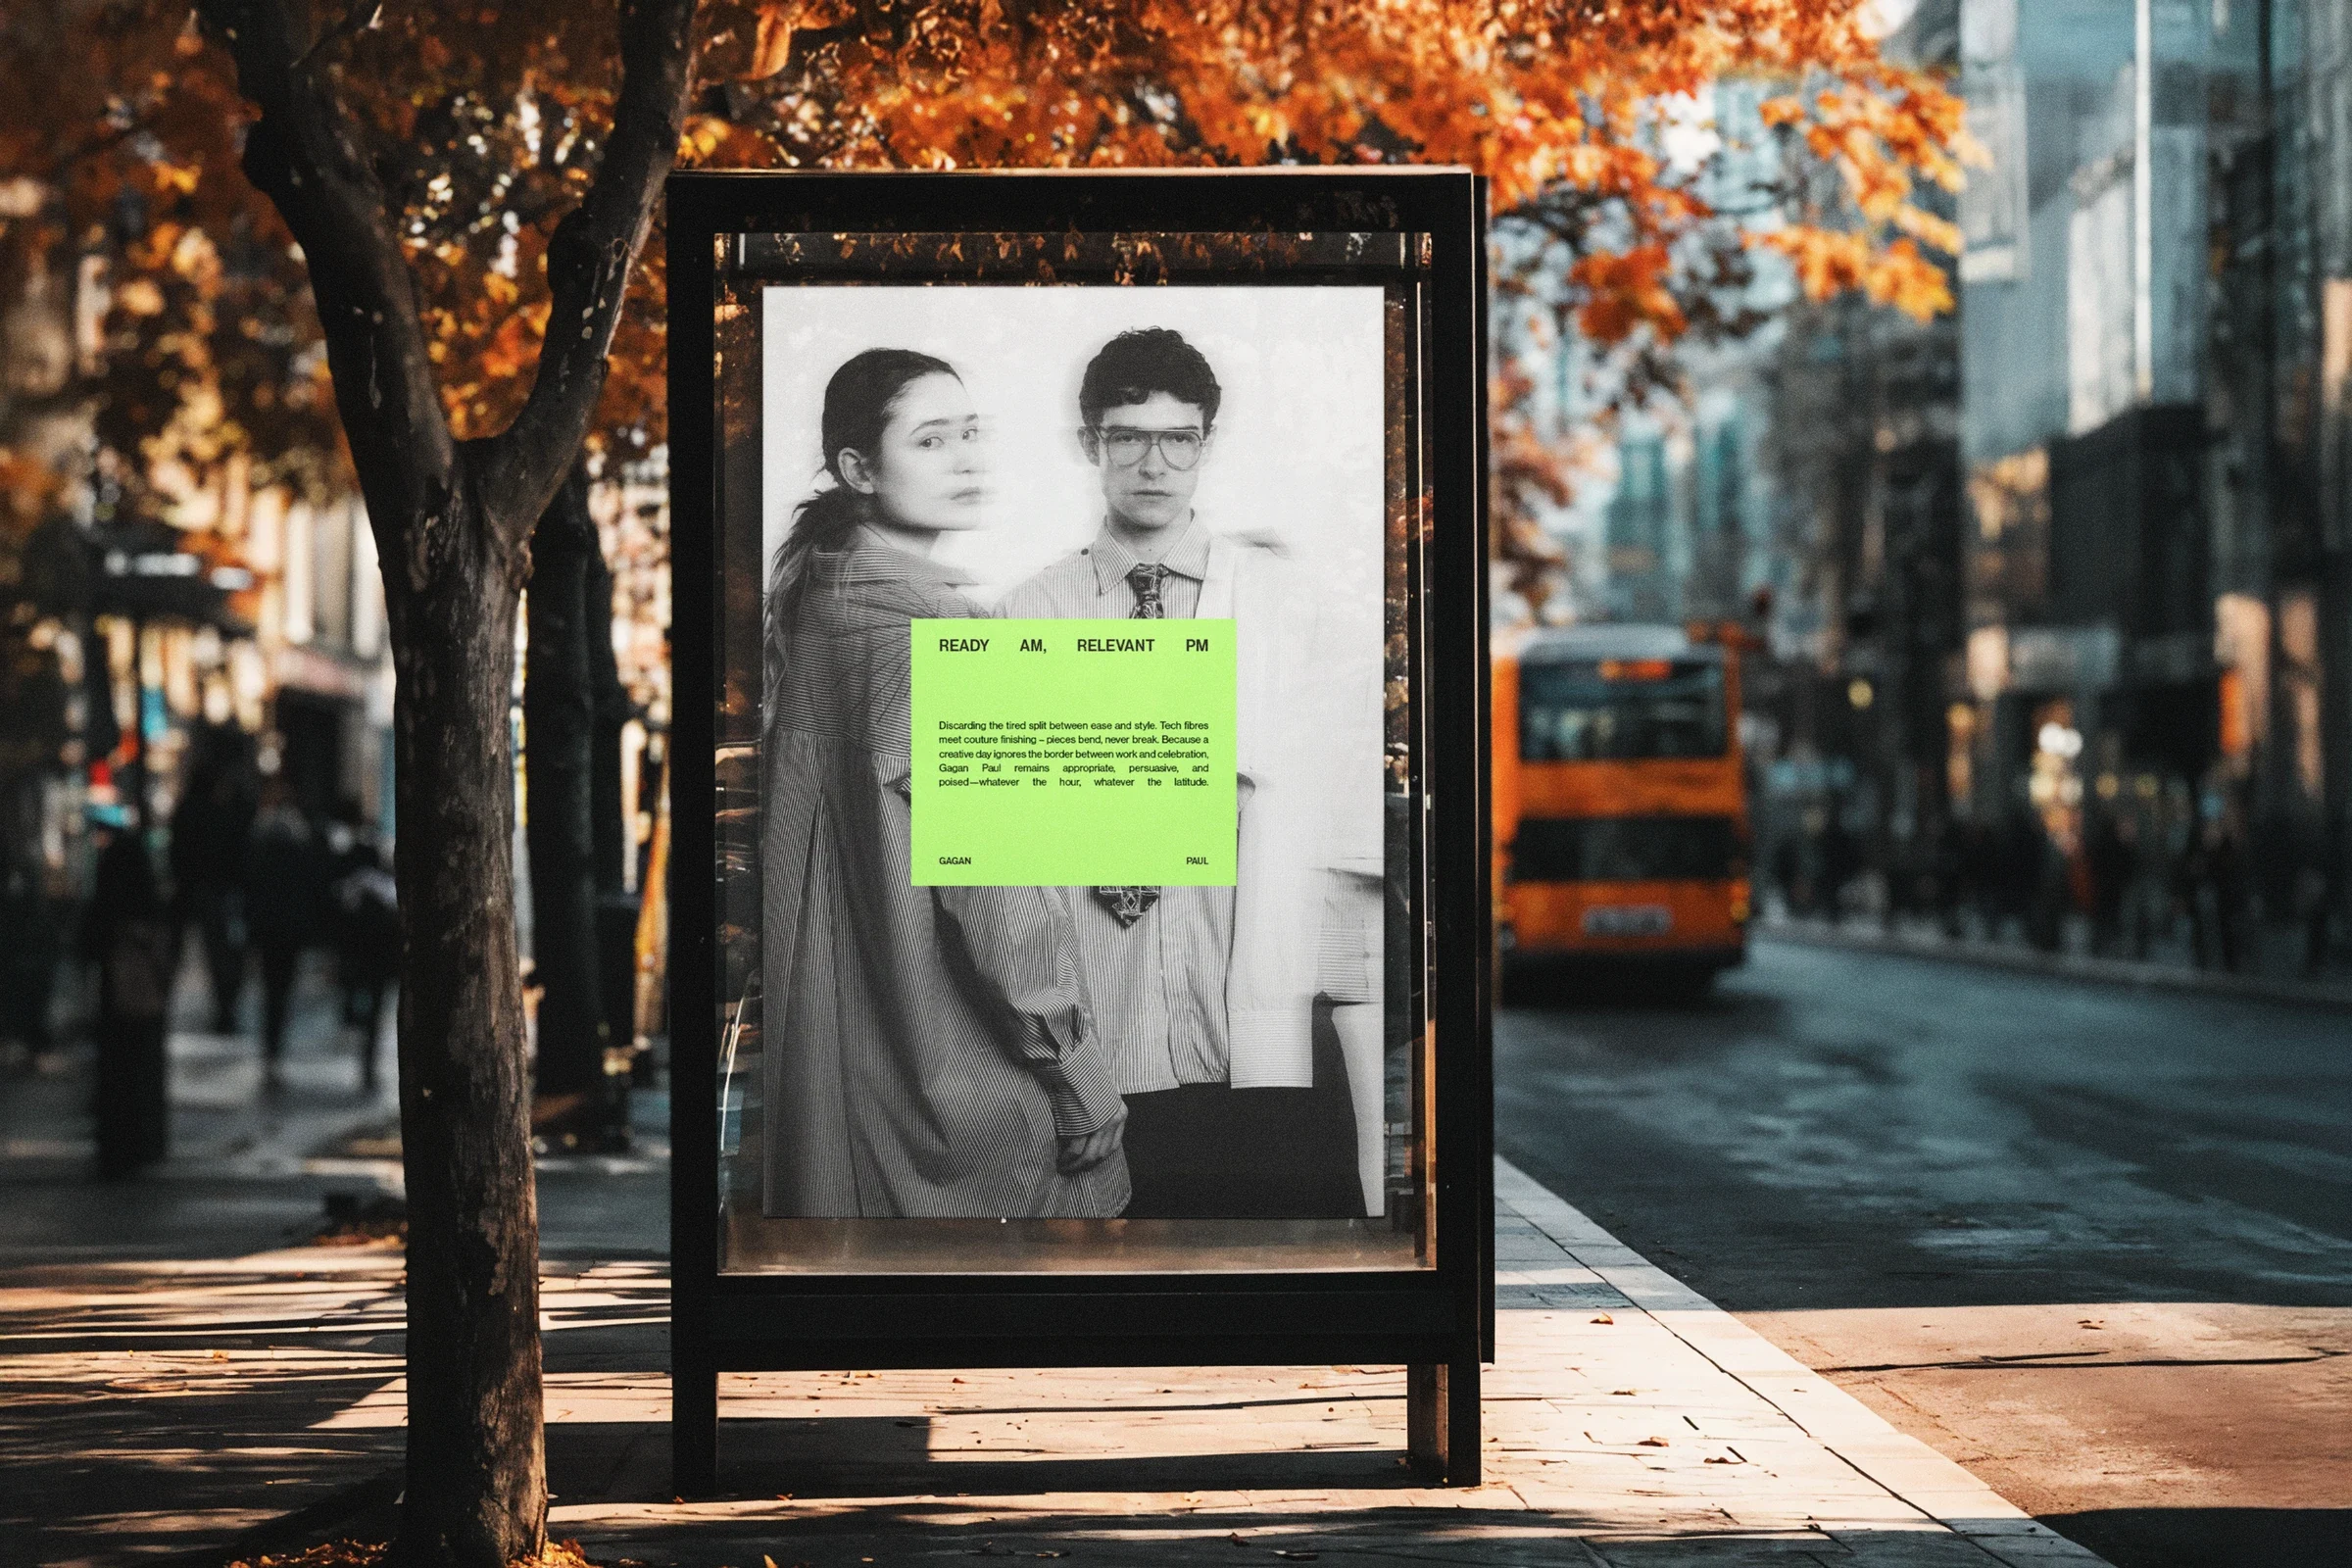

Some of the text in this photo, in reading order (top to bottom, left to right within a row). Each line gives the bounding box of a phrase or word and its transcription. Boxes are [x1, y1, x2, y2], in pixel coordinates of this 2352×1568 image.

[939, 639, 1209, 655] READY AM, RELEVANT PM
[939, 721, 987, 732] Discarding
[989, 721, 1004, 730] the
[1005, 721, 1027, 730] tired
[1028, 721, 1047, 732] split
[1049, 721, 1089, 730] between
[1113, 721, 1132, 730] and
[1134, 721, 1157, 732] style.
[1159, 721, 1182, 730] Tech
[1184, 721, 1209, 730] fibres
[1000, 735, 1037, 746] finishing
[1046, 735, 1077, 746] pieces
[1078, 736, 1103, 745] bend,
[1132, 735, 1160, 744] break.
[1161, 735, 1201, 744] Because
[938, 750, 1209, 760] creative day ignores the border between work and celebration,
[938, 763, 1209, 774] Gagan Paul remains appropriate, persuasive, and
[1032, 778, 1048, 787] the
[1058, 778, 1082, 787] hour,
[1093, 778, 1136, 787] whatever
[1147, 778, 1162, 787] the
[1174, 778, 1209, 787] latitude.
